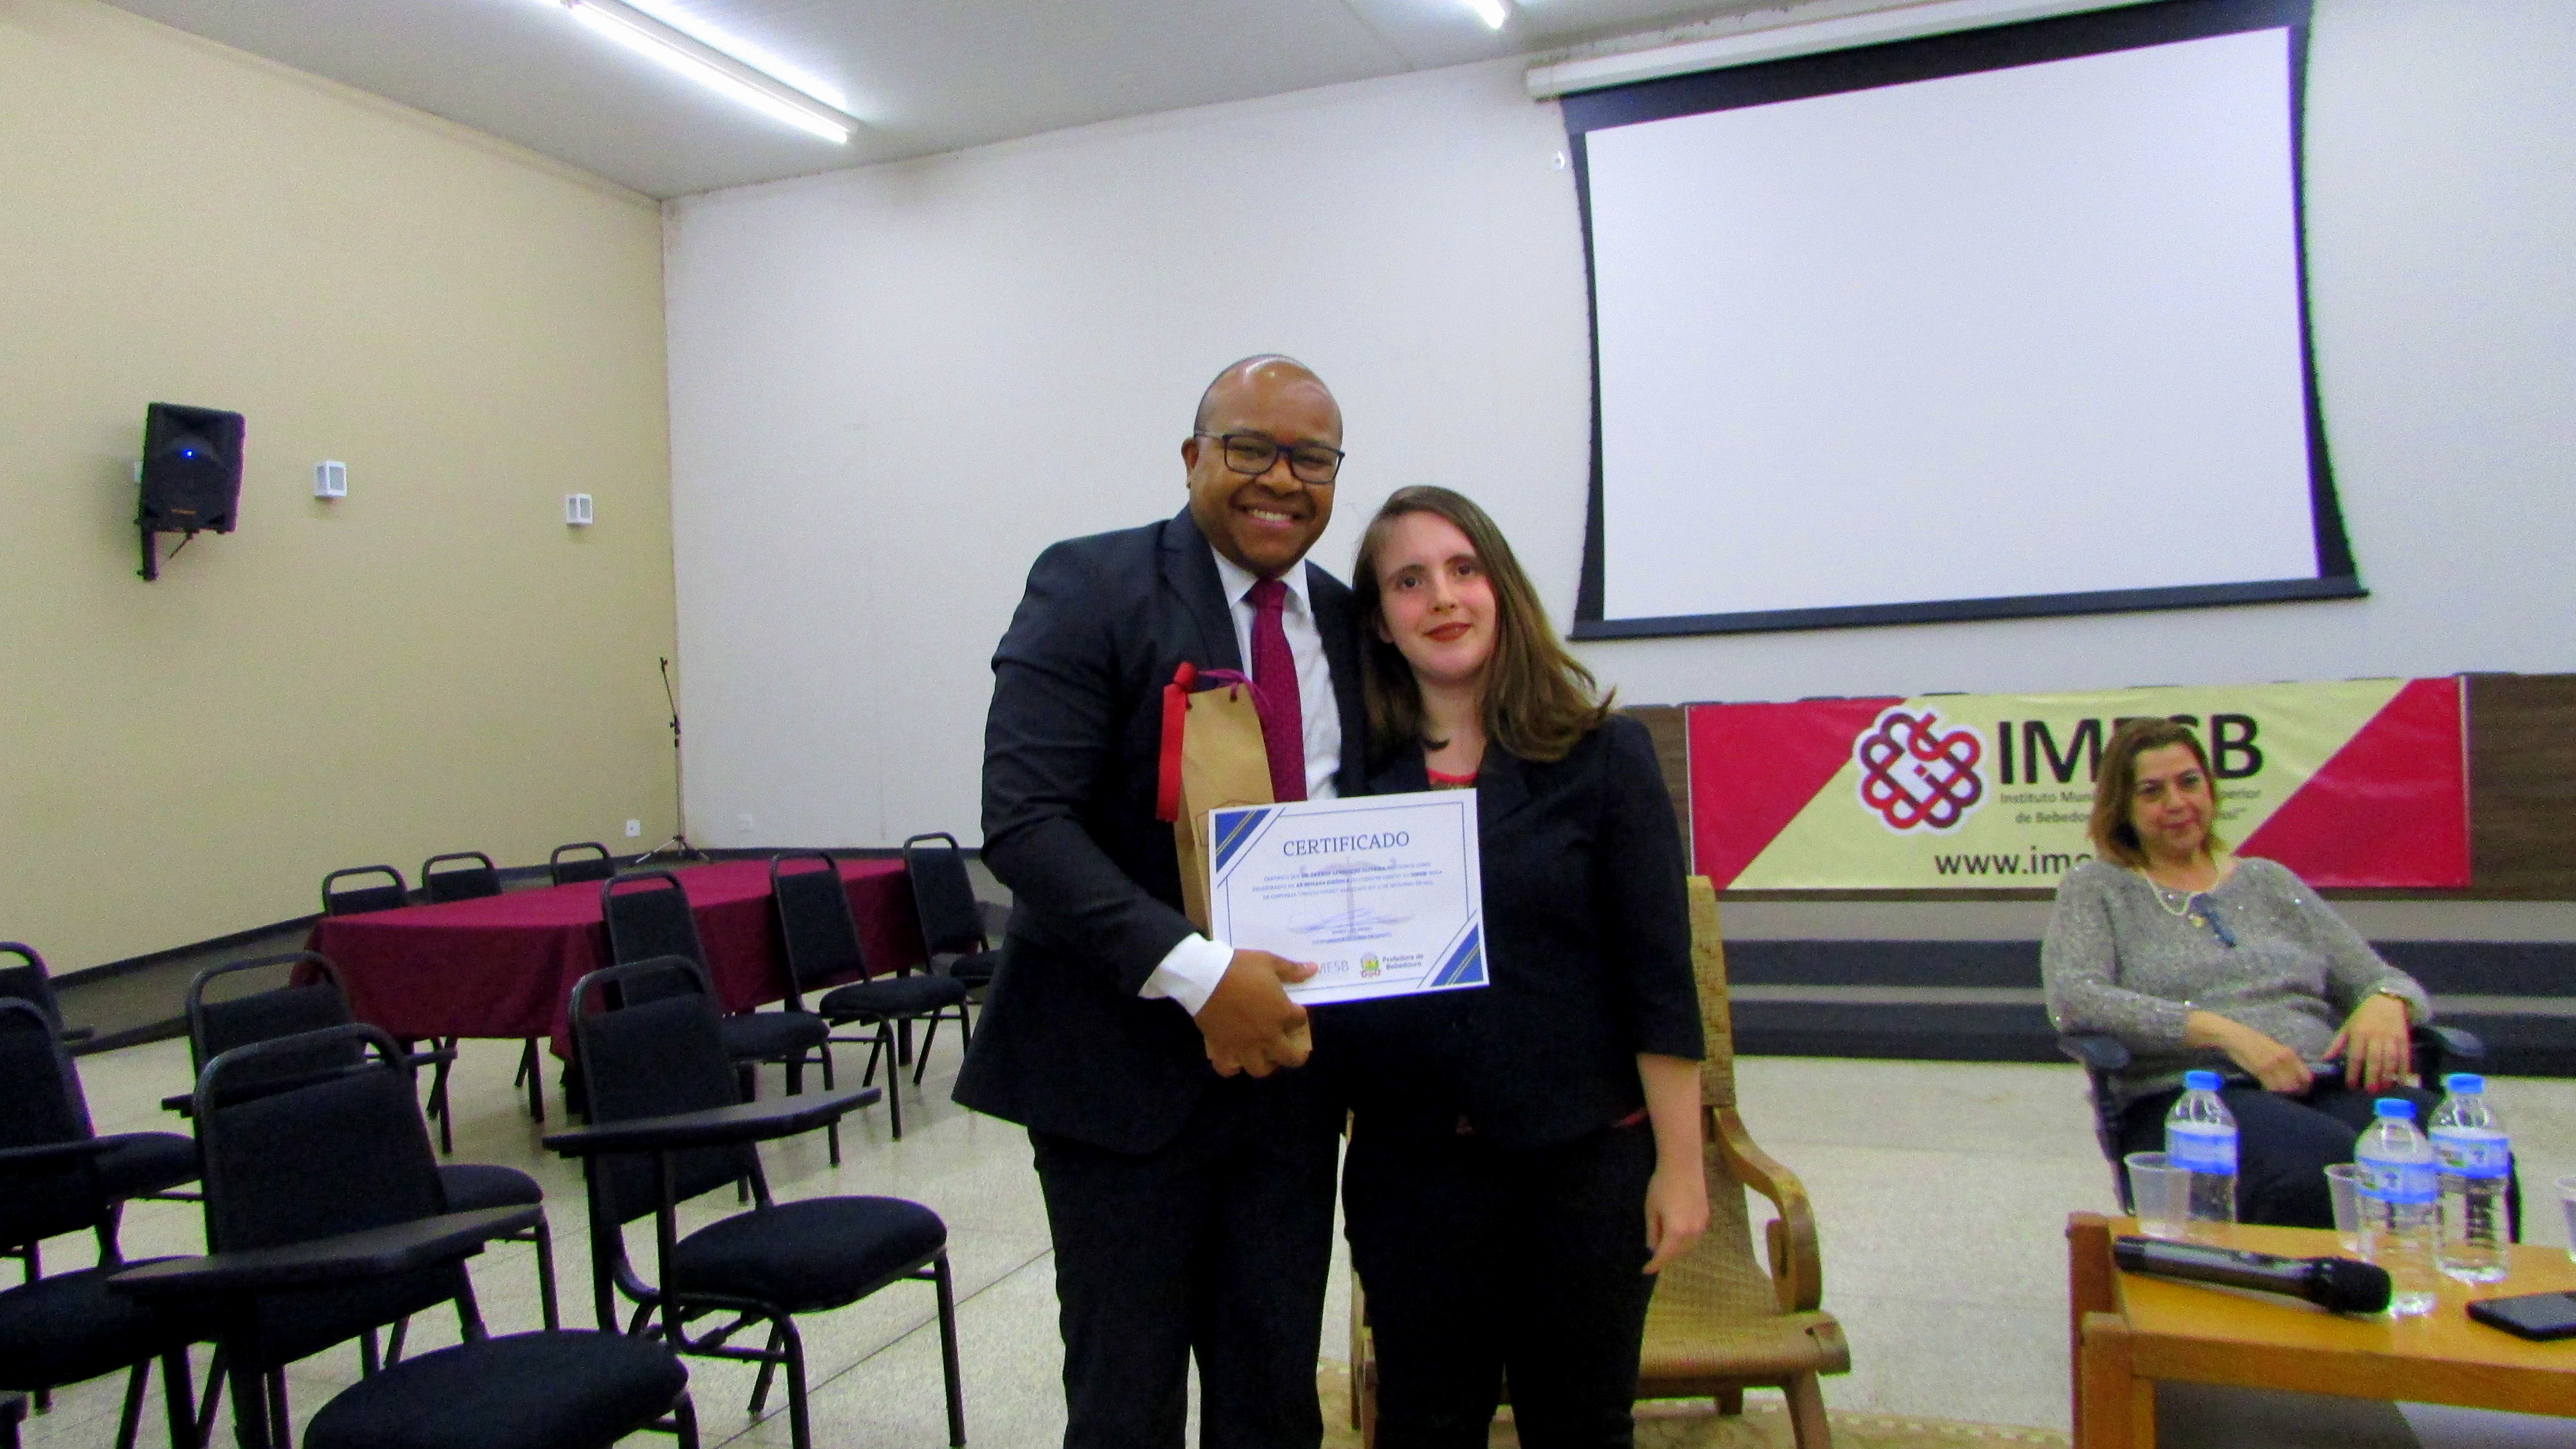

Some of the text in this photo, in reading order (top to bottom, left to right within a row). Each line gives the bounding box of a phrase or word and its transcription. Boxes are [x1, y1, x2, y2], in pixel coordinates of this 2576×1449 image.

[1998, 713, 2264, 784] IMB
[2000, 793, 2057, 803] Instituto
[2015, 812, 2031, 823] de
[1283, 831, 1409, 856] CERTIFICADO
[1934, 845, 2092, 875] www.im
[1319, 960, 1349, 974] MESB
